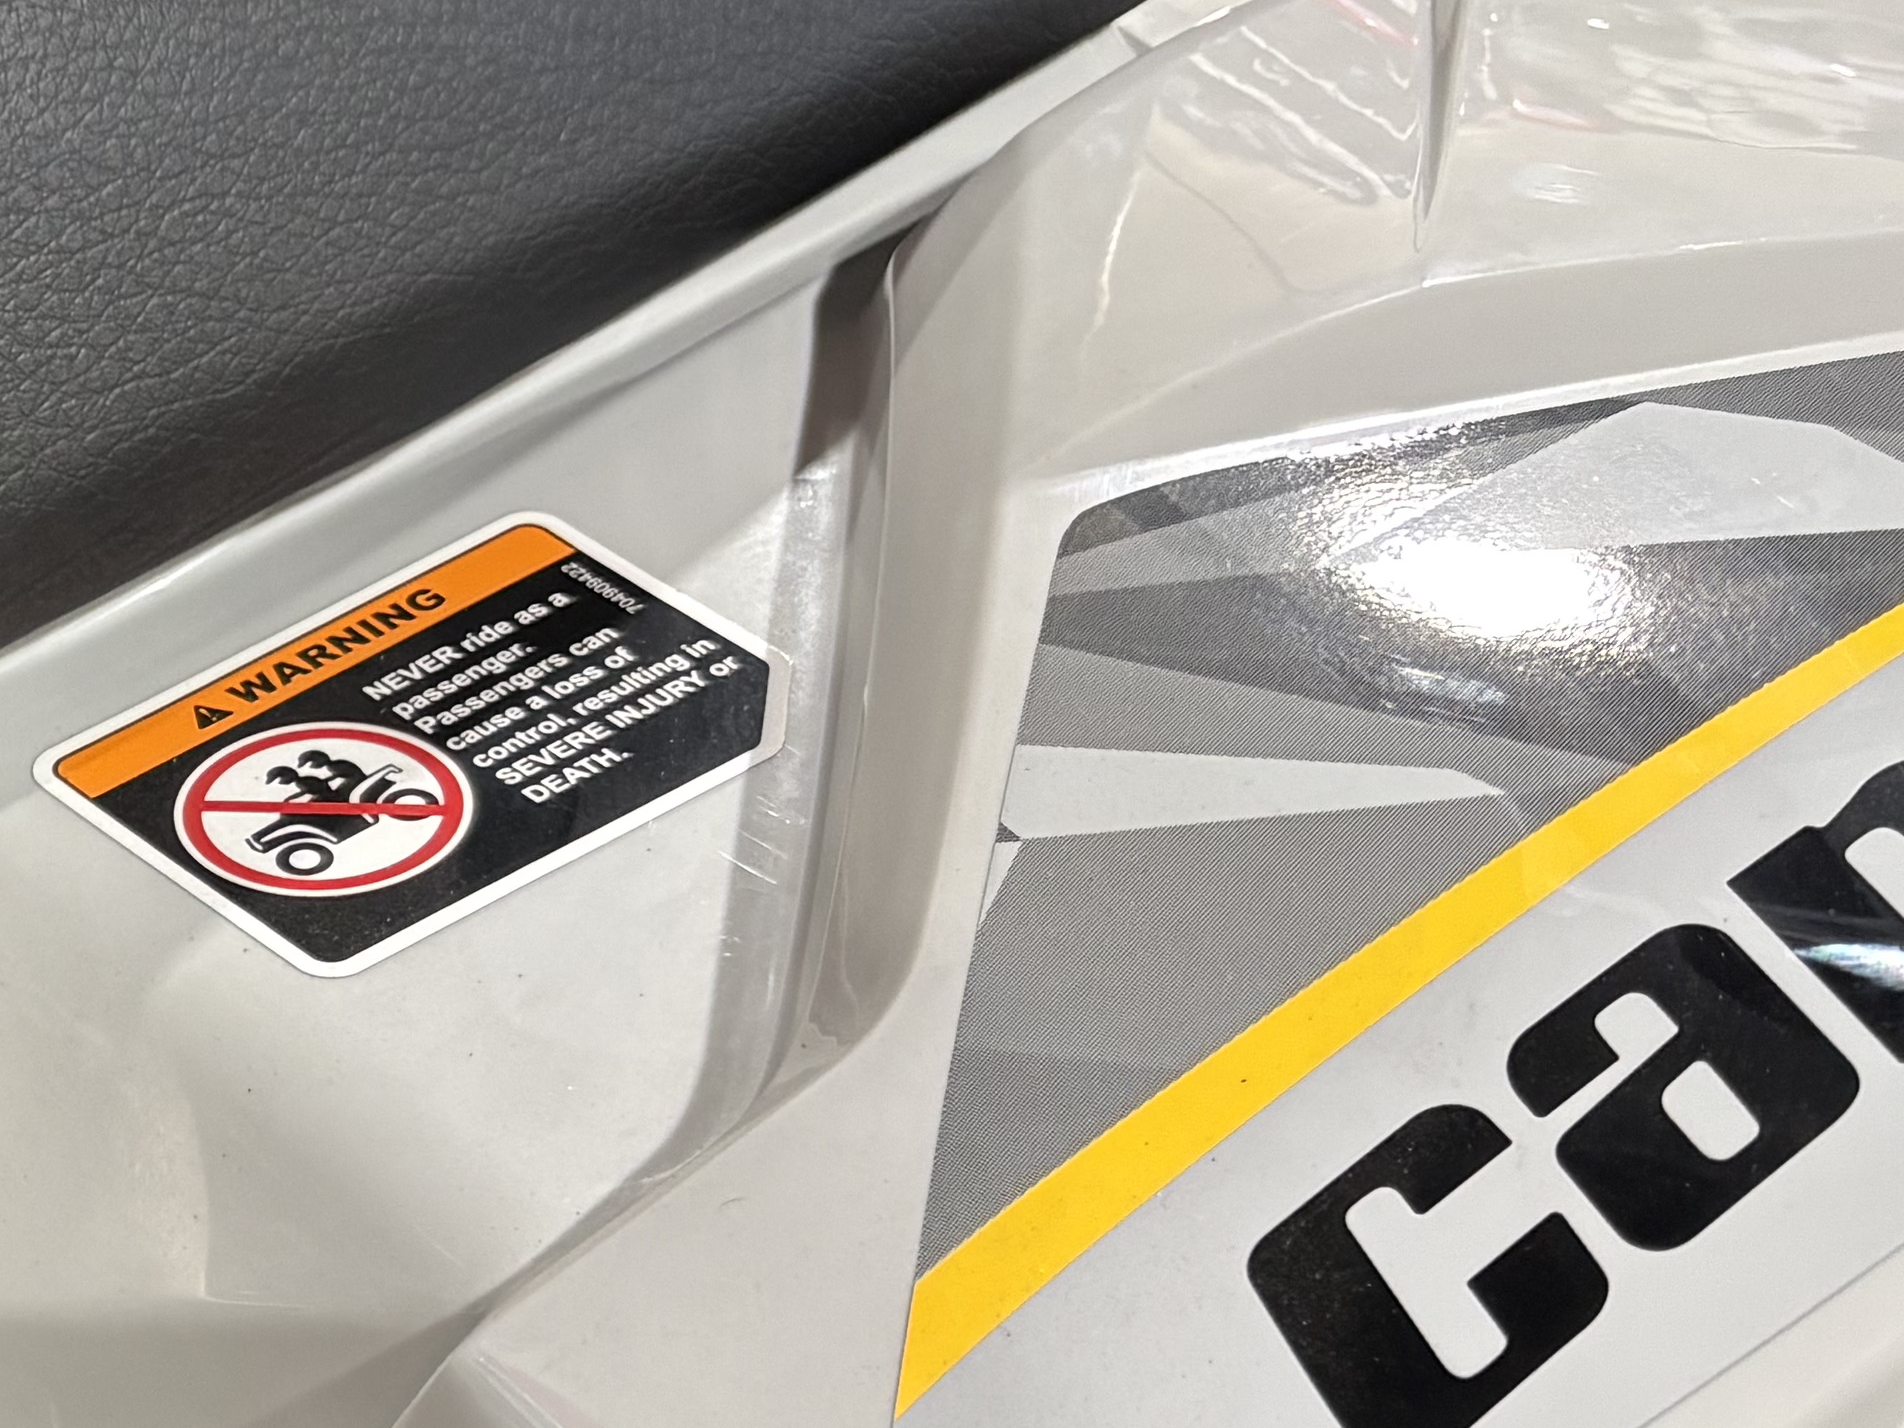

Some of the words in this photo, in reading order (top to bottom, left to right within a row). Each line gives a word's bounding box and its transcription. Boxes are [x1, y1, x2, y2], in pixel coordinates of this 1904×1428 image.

[224, 588, 446, 703] WARNING
[361, 645, 464, 702] NEVER
[460, 621, 514, 654] ride
[514, 601, 552, 626] as
[547, 592, 573, 609] a
[391, 642, 535, 722] passenger.
[414, 651, 568, 735] Passengers
[568, 626, 622, 657] can
[444, 705, 529, 752] cause
[524, 693, 551, 712] a
[545, 665, 601, 699] loss
[604, 645, 638, 670] of
[472, 713, 577, 769] control,
[574, 652, 688, 719] resulting
[685, 637, 717, 659] in
[495, 723, 613, 786] SEVERE
[605, 673, 707, 731] INJURY
[708, 653, 743, 678] or
[521, 746, 634, 804] DEATH.
